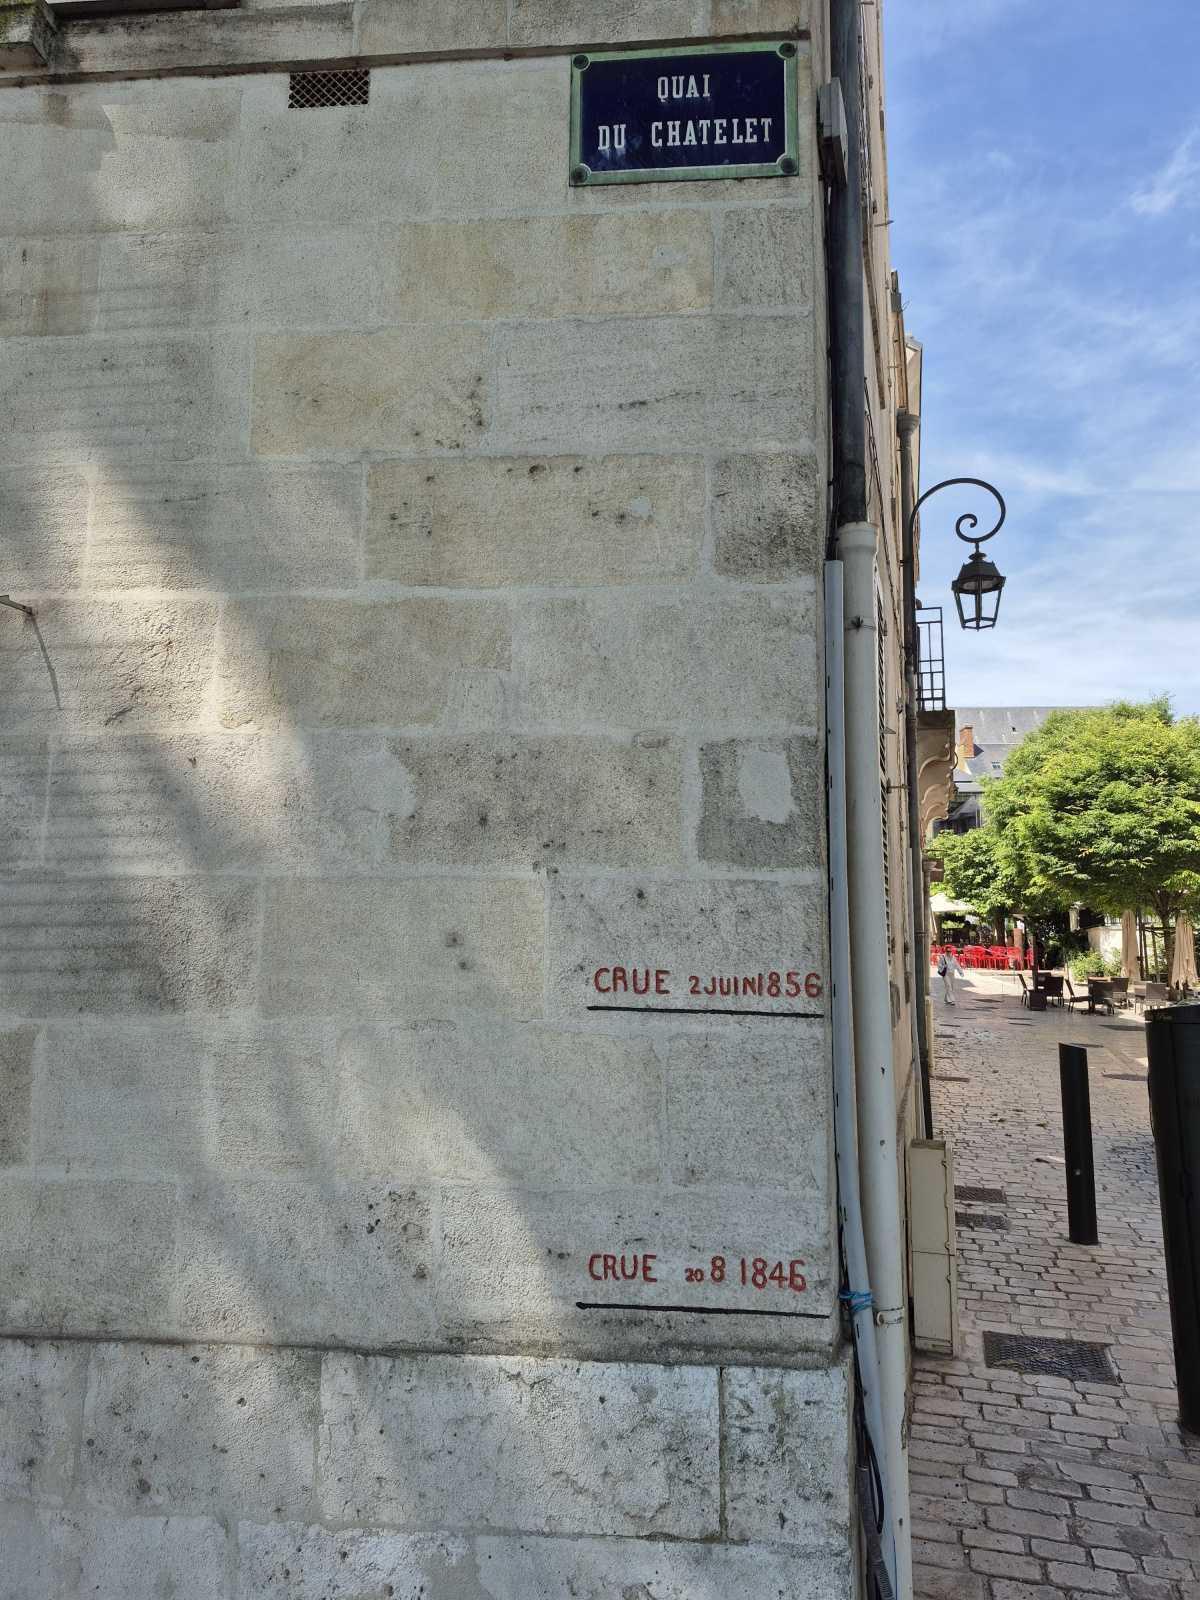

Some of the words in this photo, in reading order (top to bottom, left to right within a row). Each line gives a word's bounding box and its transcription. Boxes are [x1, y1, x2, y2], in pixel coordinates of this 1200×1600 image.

[657, 74, 711, 102] QUAI
[598, 123, 627, 150] DU
[651, 117, 772, 147] CHATELET
[593, 967, 671, 995] CRUE
[588, 1253, 657, 1282] CRUE
[740, 1257, 807, 1292] 1846
